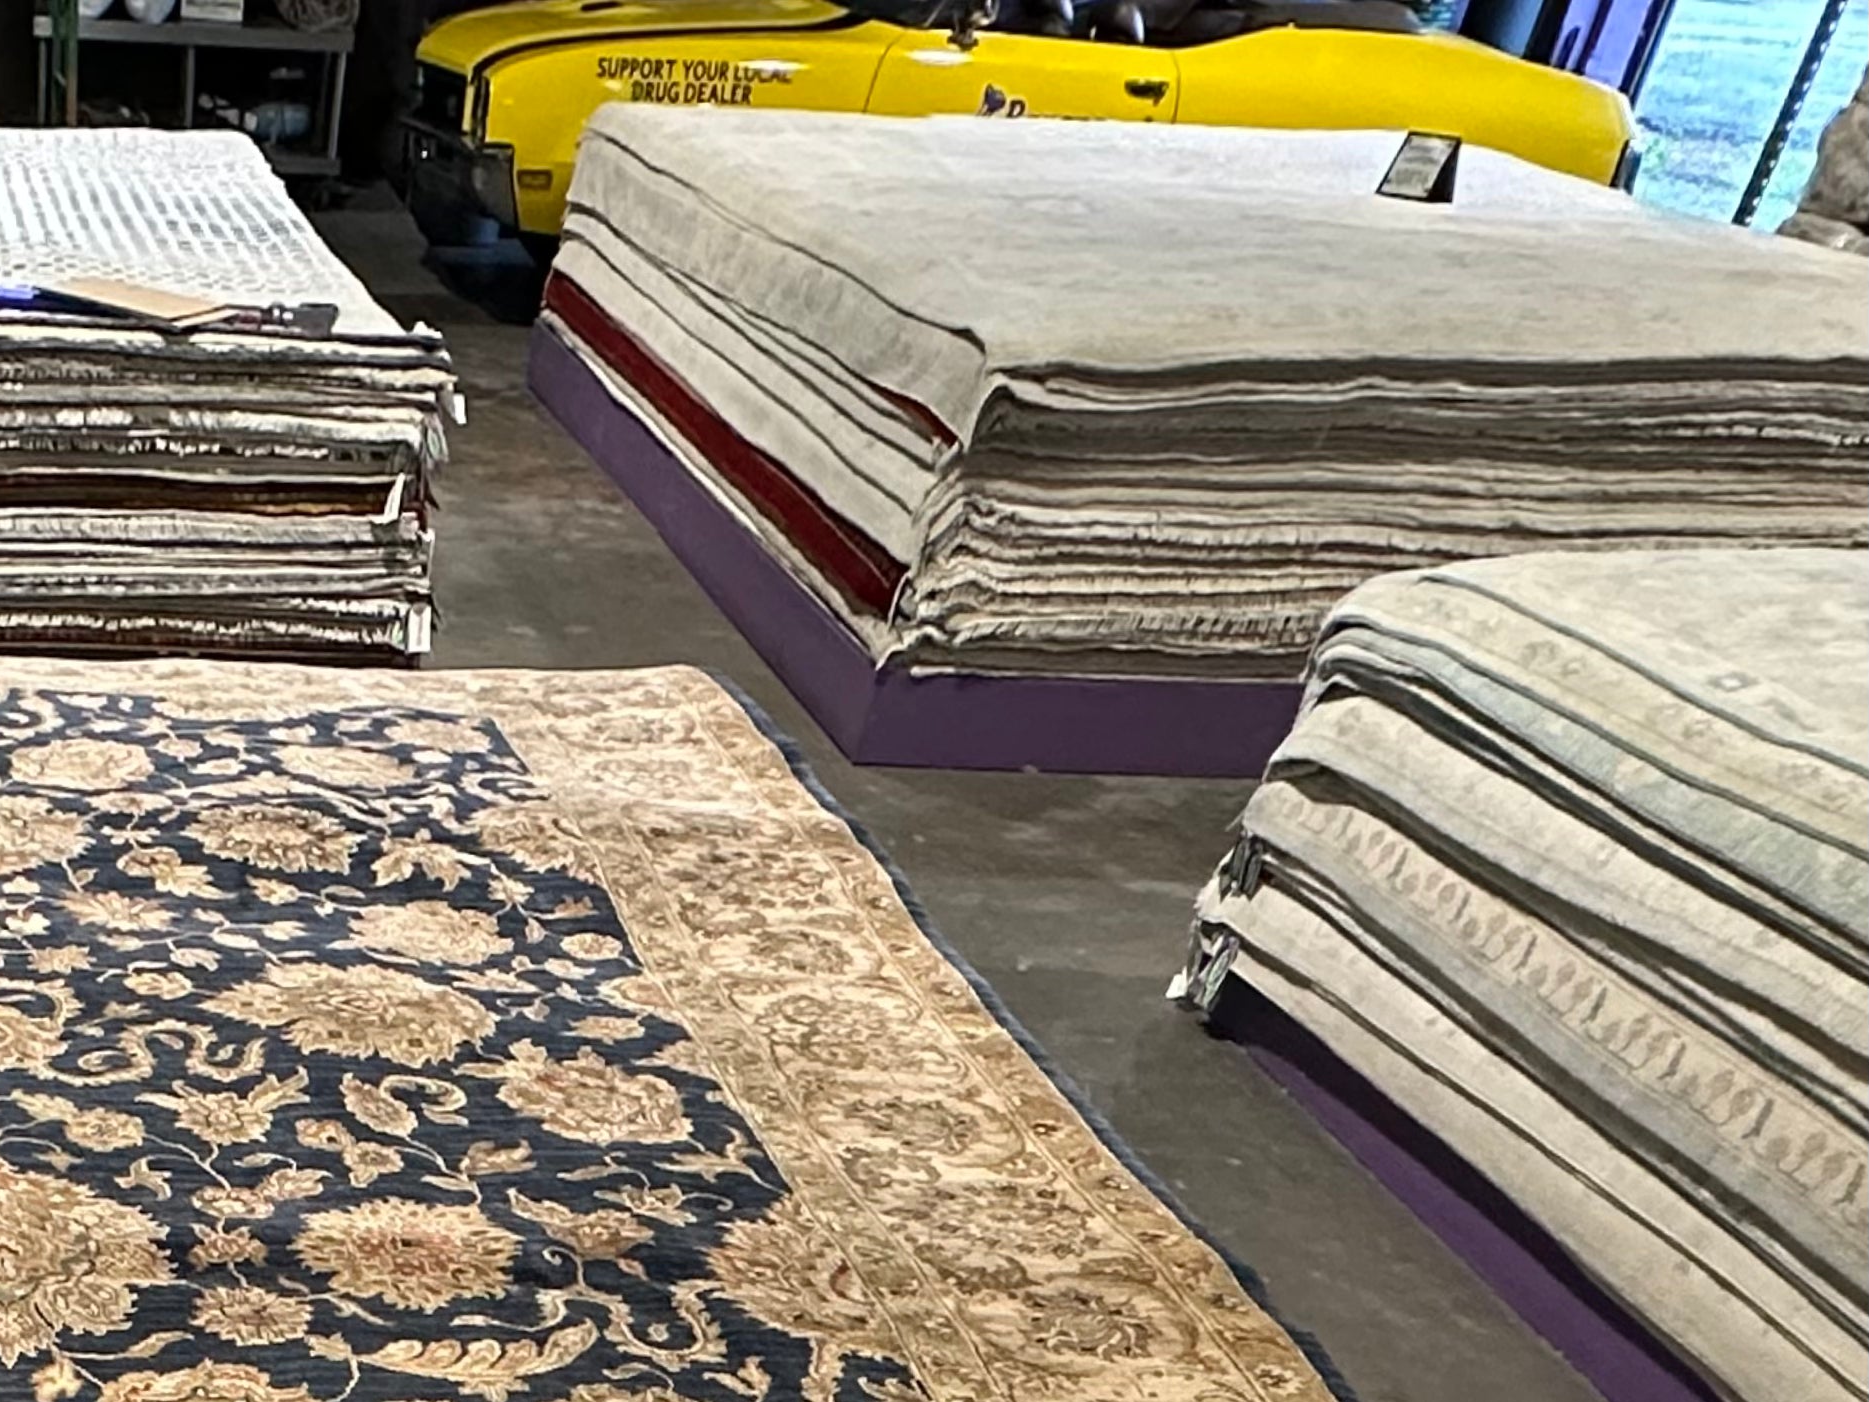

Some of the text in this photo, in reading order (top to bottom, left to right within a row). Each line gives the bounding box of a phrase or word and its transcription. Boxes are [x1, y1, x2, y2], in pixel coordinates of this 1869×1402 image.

[597, 57, 677, 80] SUPPORT
[683, 60, 730, 82] YOUR
[631, 80, 753, 105] DRUG DEALER
